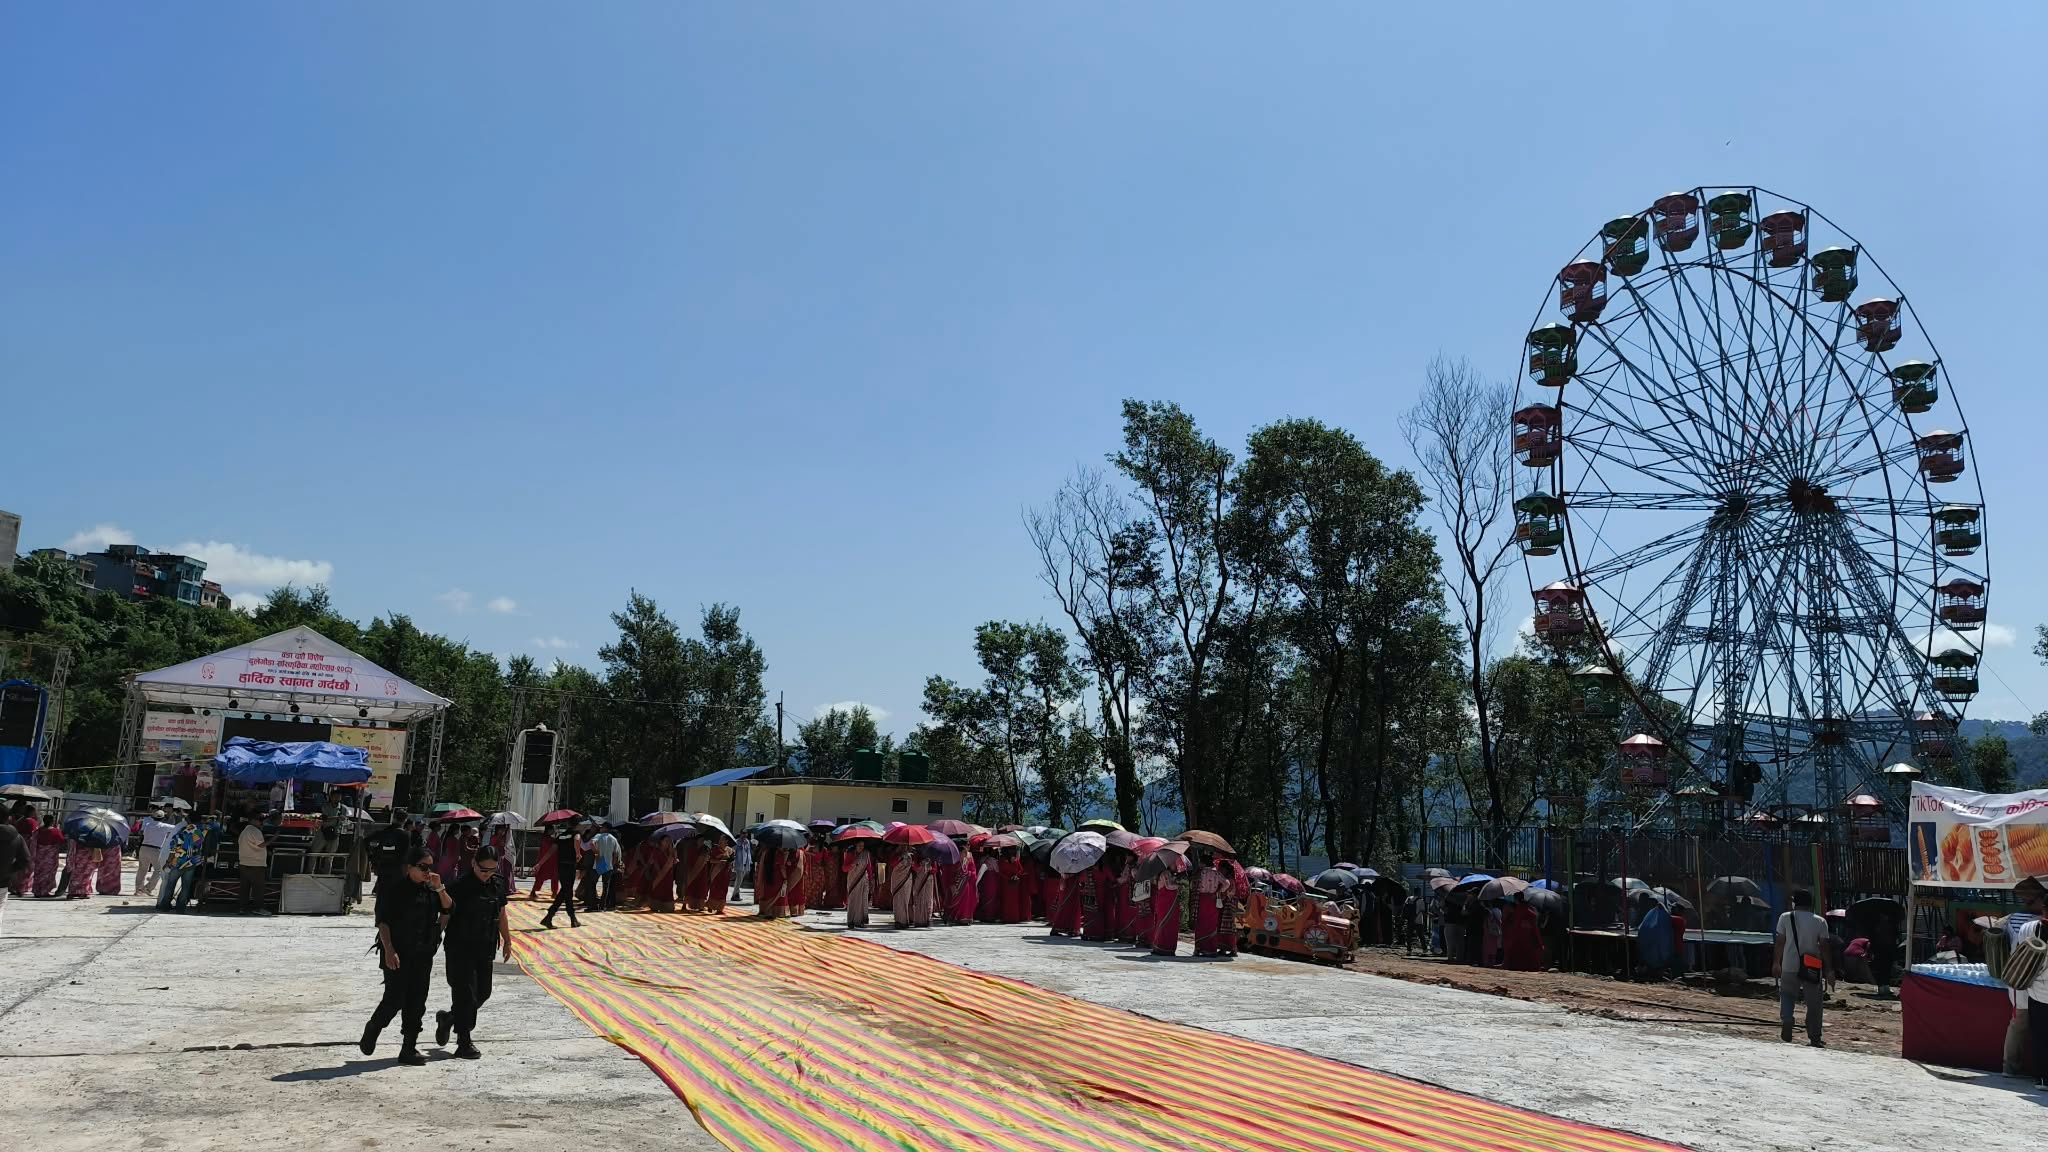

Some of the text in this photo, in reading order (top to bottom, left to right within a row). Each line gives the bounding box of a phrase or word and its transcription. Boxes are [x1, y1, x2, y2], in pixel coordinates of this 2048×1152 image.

[238, 671, 275, 684] हार्दिक
[279, 676, 314, 688] स्वागत
[1911, 796, 1944, 811] TikTok
